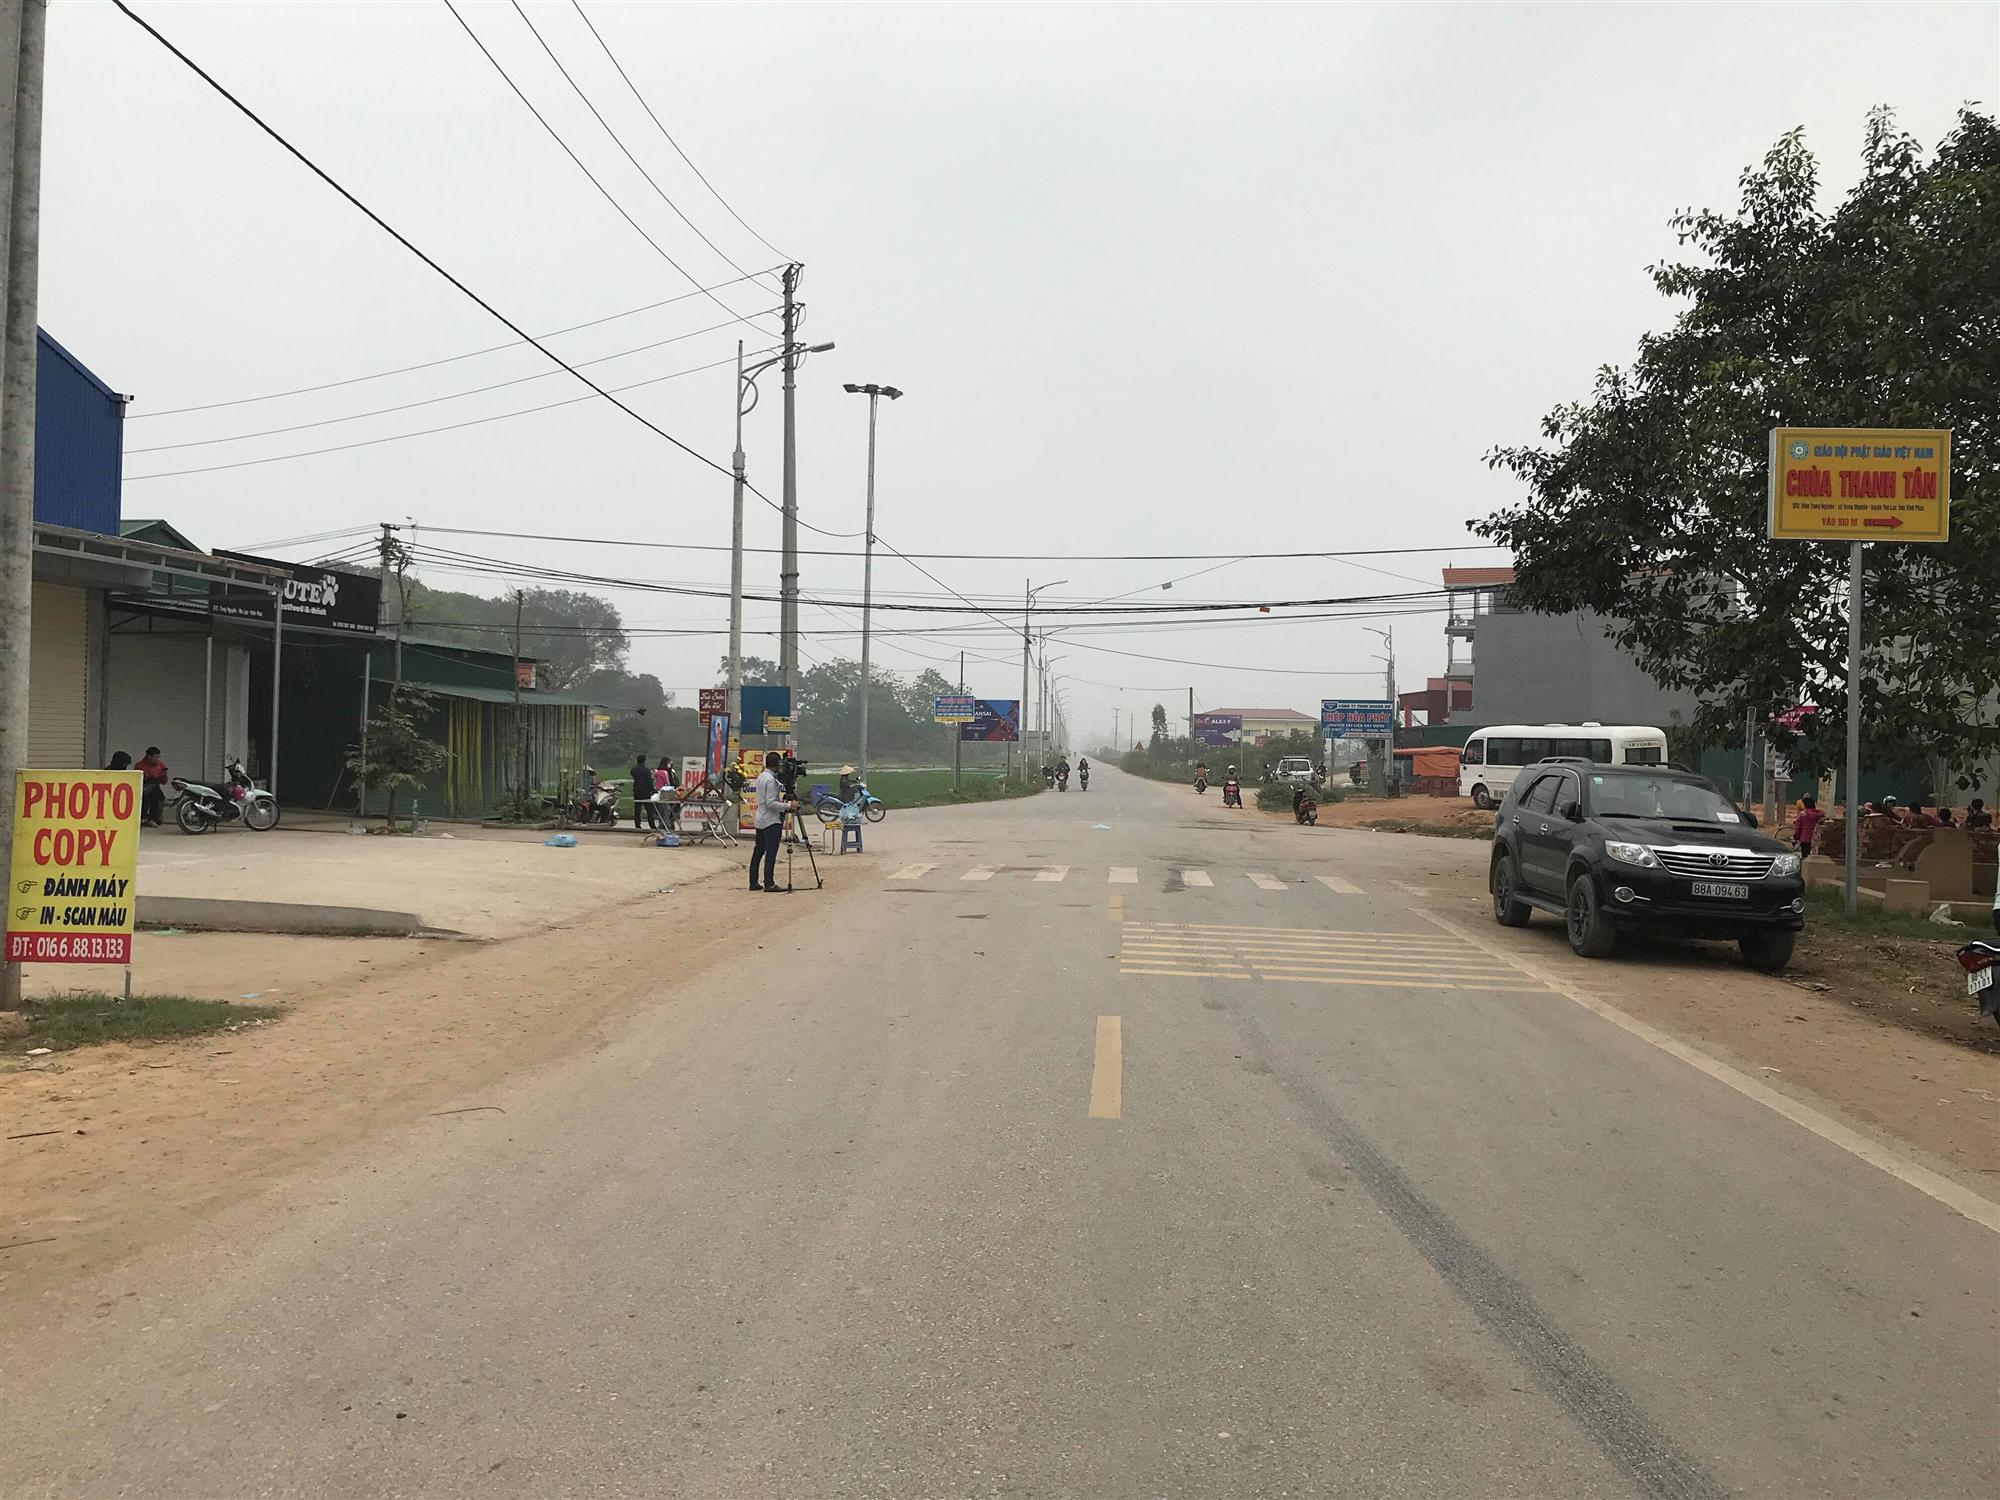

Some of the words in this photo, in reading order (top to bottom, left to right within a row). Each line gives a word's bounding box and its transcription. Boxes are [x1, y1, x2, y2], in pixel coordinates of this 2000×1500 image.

[1814, 443, 1832, 457] GIÁO
[1834, 444, 1848, 459] HỘI
[1850, 444, 1871, 459] PHẬT
[1873, 444, 1892, 458] GIÁO
[1894, 445, 1912, 460] VIỆT
[1914, 447, 1934, 458] NAM
[1786, 465, 1832, 497] CHÙA
[1839, 471, 1896, 498] THANH
[1903, 466, 1937, 499] TÂN
[1822, 515, 1836, 526] VÀO
[1838, 517, 1849, 526] 100
[284, 579, 322, 604] UTE
[1323, 711, 1345, 722] THÉP
[1346, 710, 1366, 722] HÒA
[22, 781, 134, 821] PHOTO
[33, 827, 118, 866] COPY
[44, 873, 90, 897] ĐÁNH
[91, 874, 129, 898] MÁY
[40, 906, 55, 925] IN
[63, 906, 96, 926] SCAN
[98, 903, 127, 926] MÀU
[12, 937, 33, 957] ĐT:
